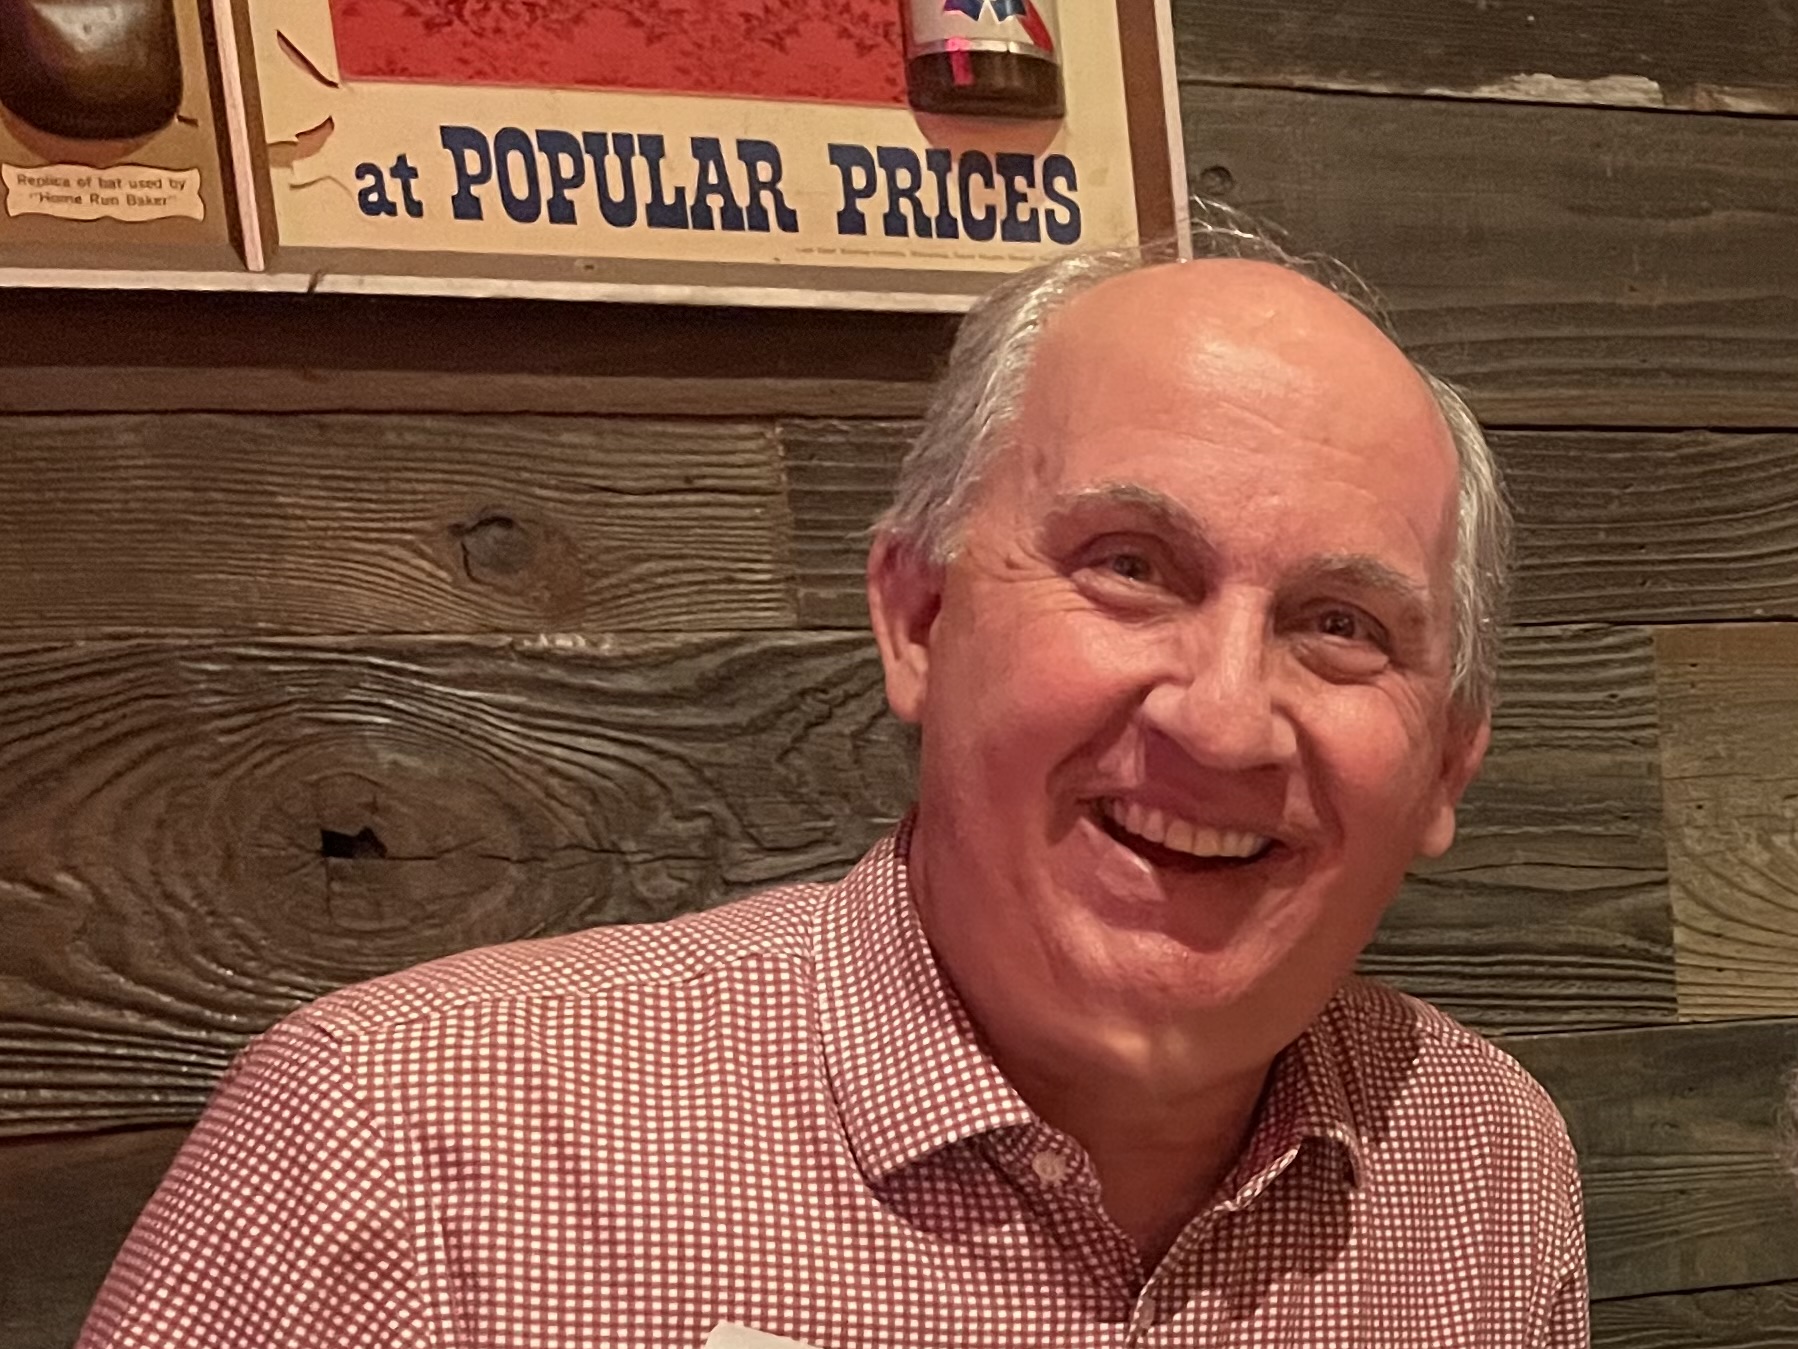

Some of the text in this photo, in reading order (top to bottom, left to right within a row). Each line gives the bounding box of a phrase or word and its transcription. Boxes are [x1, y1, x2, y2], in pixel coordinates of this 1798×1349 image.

[17, 174, 187, 191] Replica of bat used by
[354, 125, 1082, 245] at POPULAR PRICES
[90, 194, 119, 206] Run
